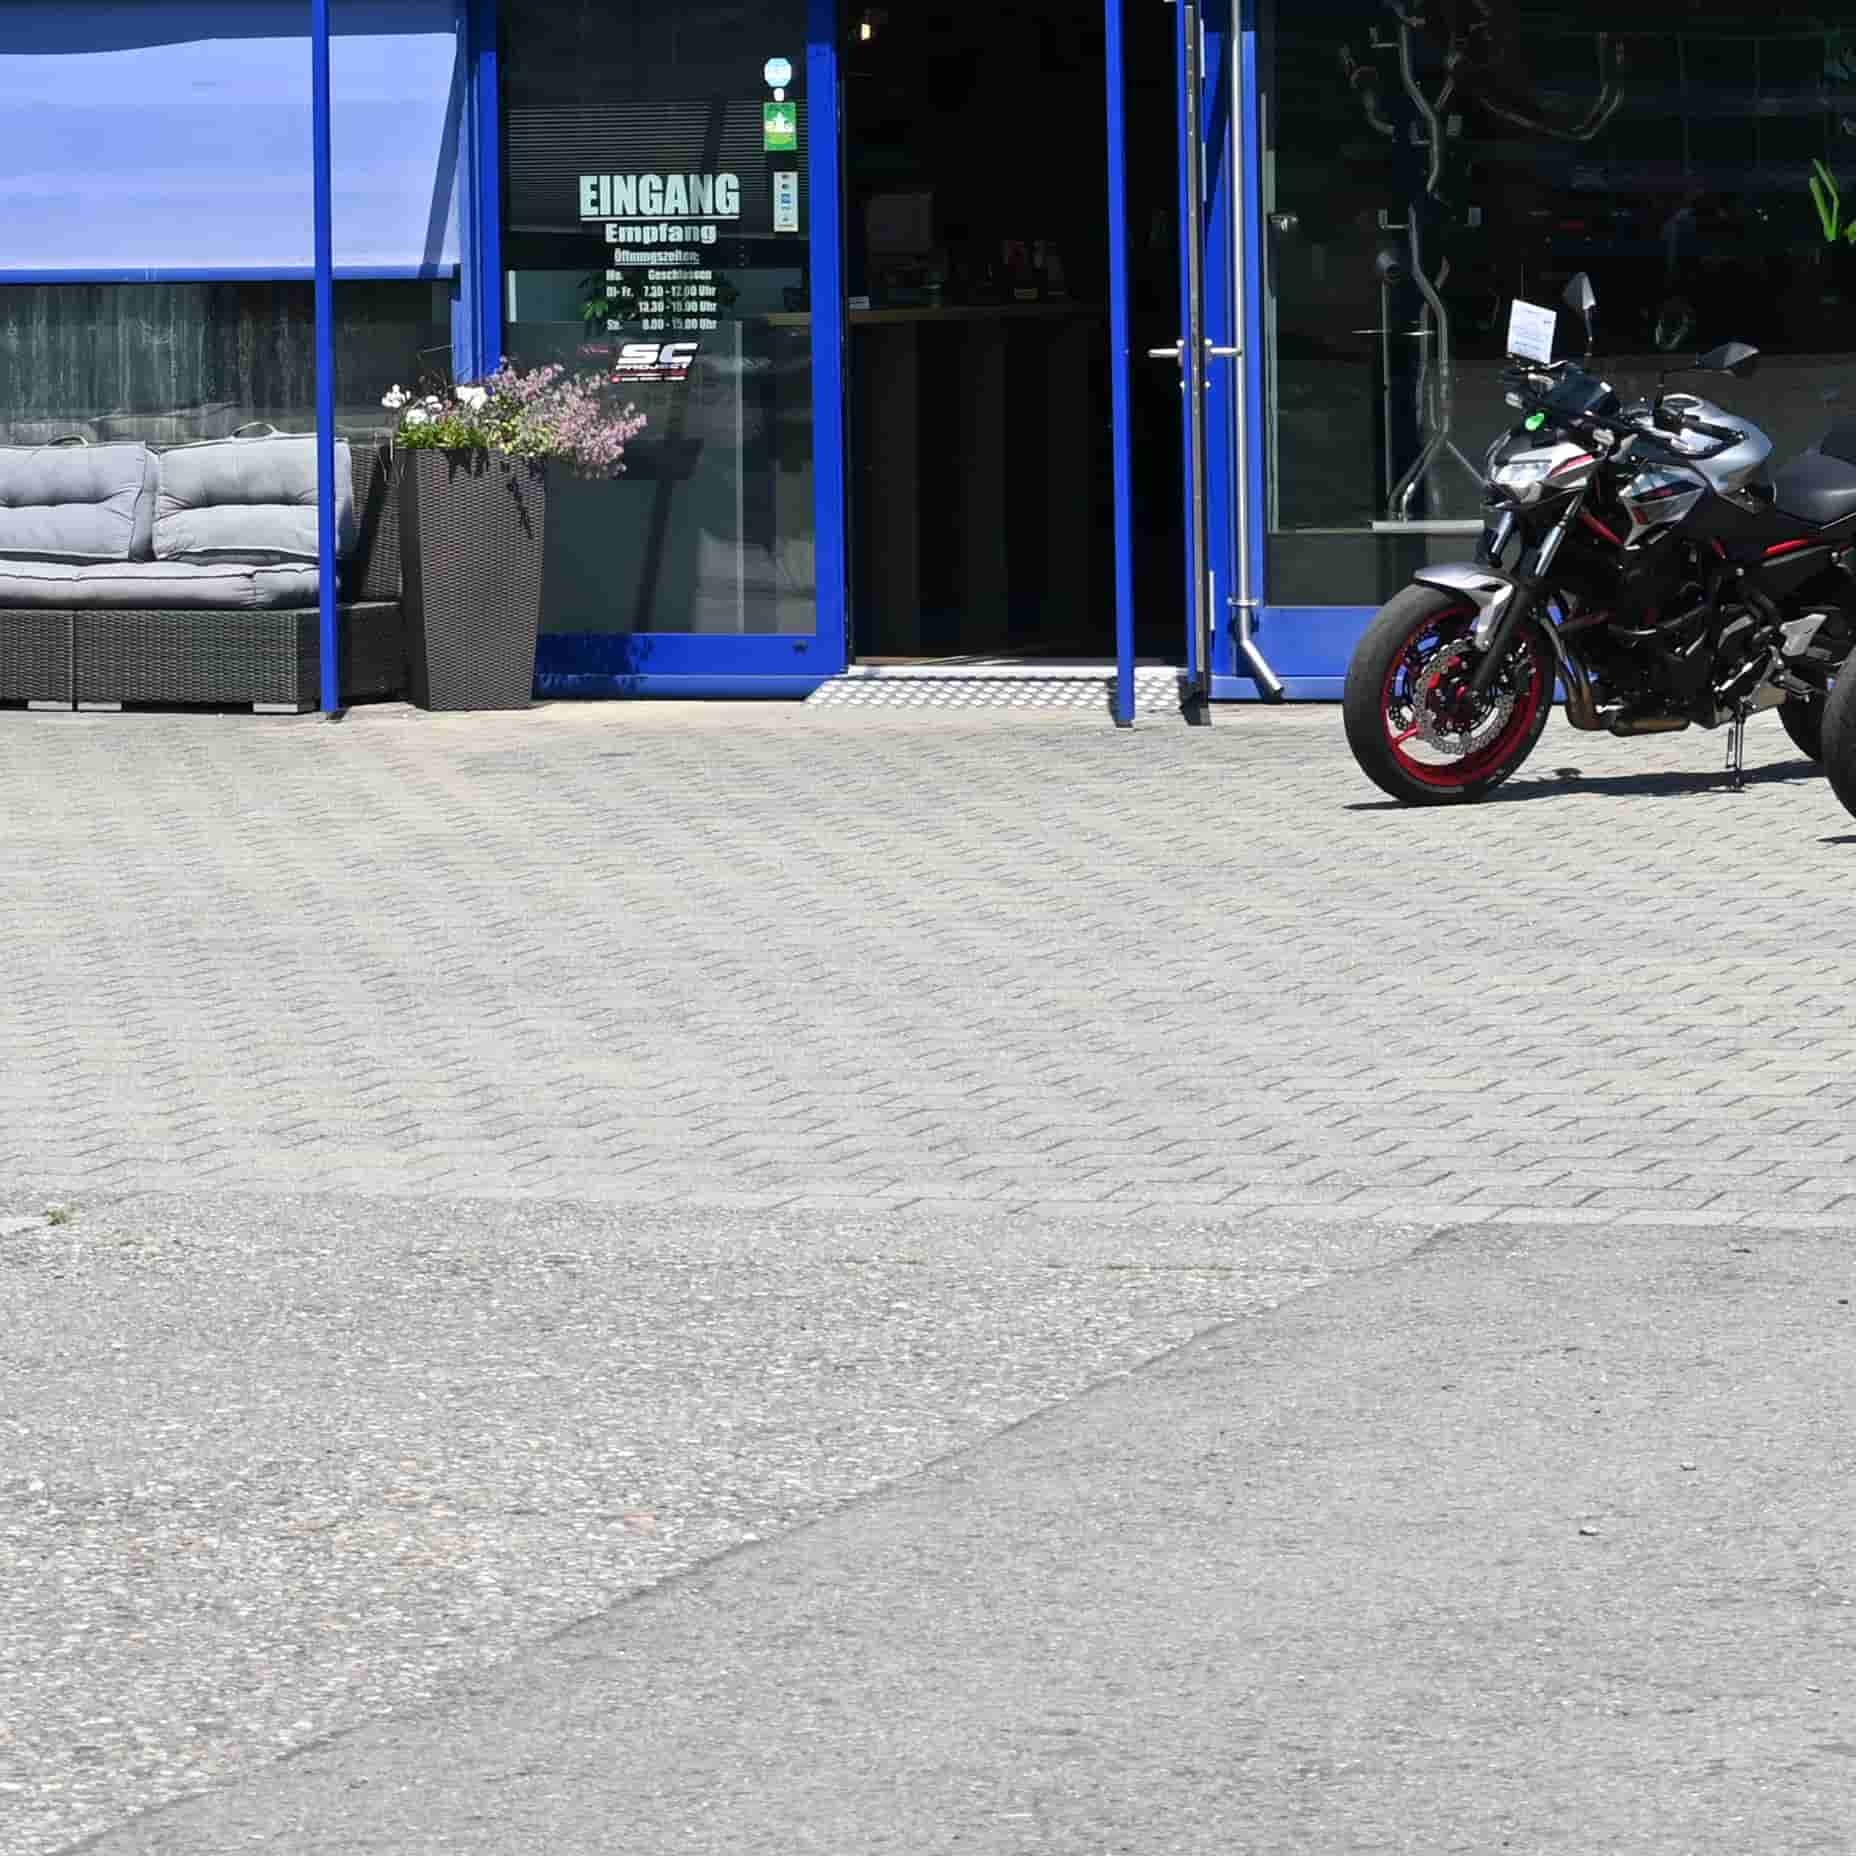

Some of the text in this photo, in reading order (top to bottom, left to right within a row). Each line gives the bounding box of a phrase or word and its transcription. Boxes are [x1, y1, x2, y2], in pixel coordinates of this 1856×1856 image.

[579, 173, 740, 216] EINGANG
[605, 222, 717, 244] Empfang
[698, 285, 717, 296] Uhr
[699, 301, 717, 312] Uhr
[699, 318, 717, 330] Uhr
[617, 343, 699, 364] SC
